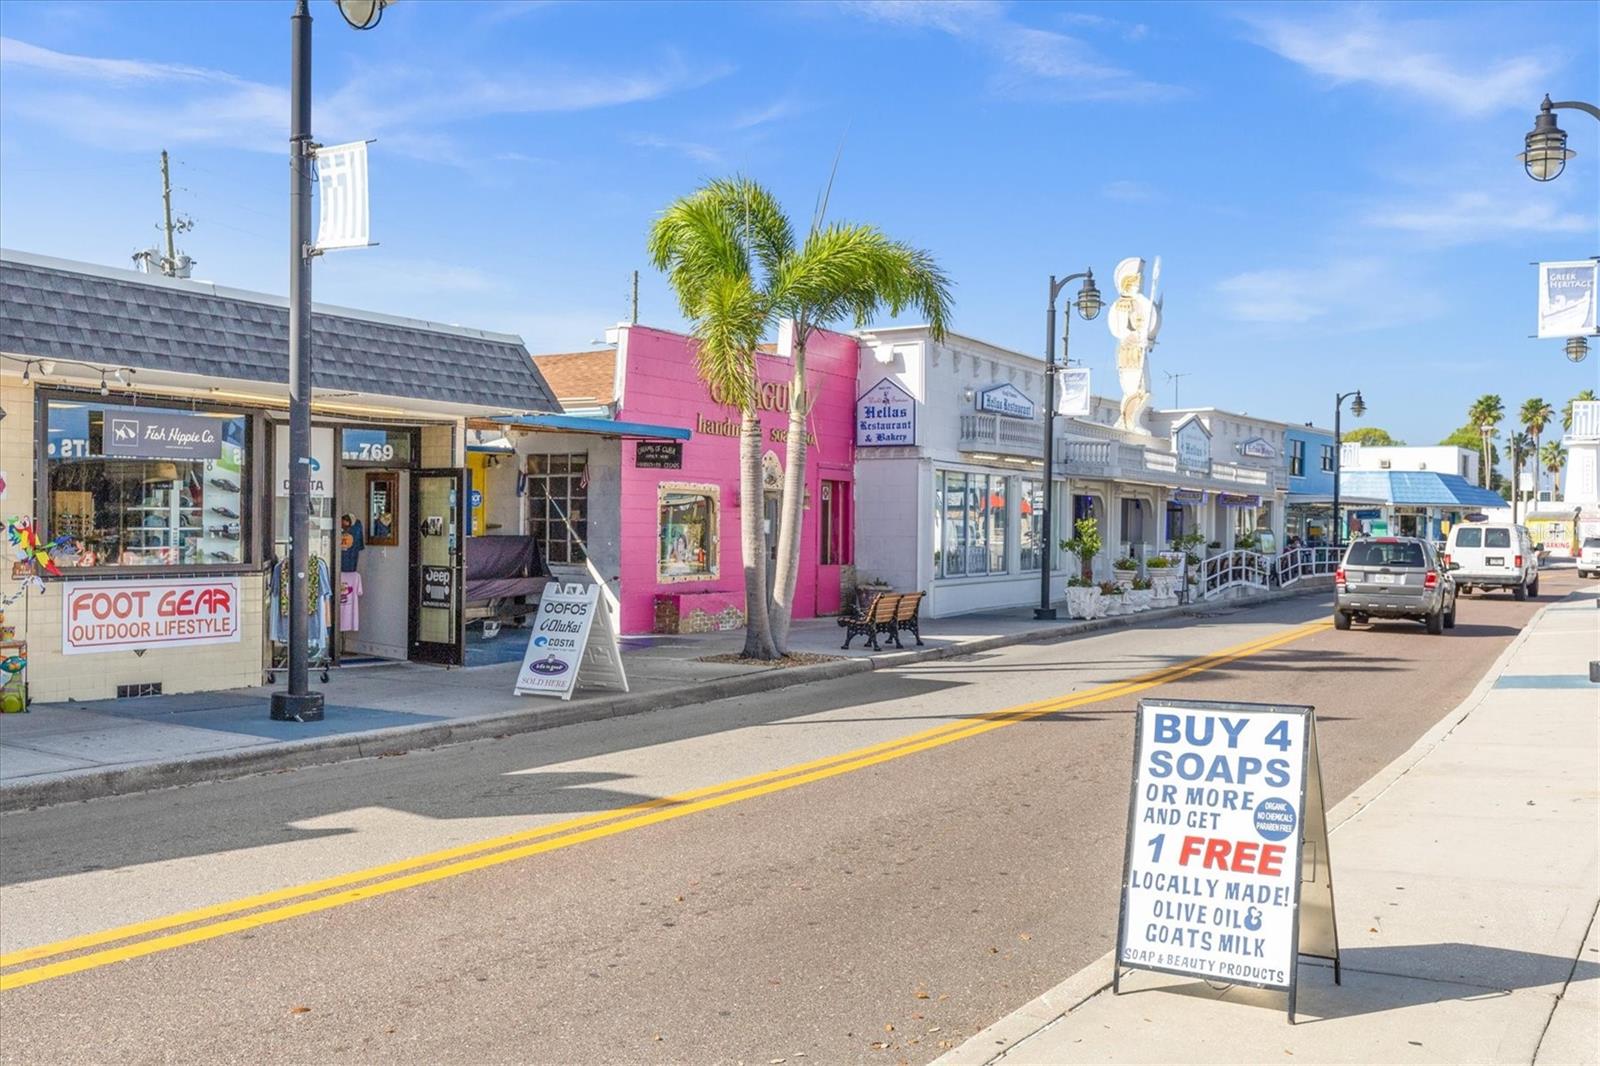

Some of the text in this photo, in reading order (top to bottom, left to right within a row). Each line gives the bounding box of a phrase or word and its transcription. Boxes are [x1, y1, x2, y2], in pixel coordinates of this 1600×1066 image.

[1550, 273, 1577, 281] GREEK
[1550, 280, 1591, 289] HERITAGE
[864, 405, 907, 418] Hellas
[860, 421, 911, 430] Restaurant
[144, 425, 215, 443] Fish Hippie Co.
[865, 433, 907, 442] & Bakery
[359, 443, 394, 460] 769
[283, 480, 324, 491] CTA
[426, 569, 450, 585] Jeep
[72, 588, 230, 621] FOOT GEAR
[544, 602, 588, 615] OOFOS
[72, 617, 230, 641] OUTDOOR LIFESTYLE
[548, 638, 575, 647] COSTA
[521, 677, 567, 687] SOLD HERE
[1153, 713, 1292, 752] BUY 4
[1148, 750, 1291, 788] SOAPS
[1146, 783, 1255, 811] OR MORE
[1265, 801, 1287, 811] ORGANIC
[1143, 807, 1221, 830] AND GET
[1257, 812, 1293, 822] NO CHEMICALS
[1256, 822, 1293, 833] PARABEN FREE
[1147, 833, 1286, 877] 1 FREE
[1132, 870, 1290, 907] LOCALLY MADE!
[1153, 900, 1207, 924] OLIVE
[1145, 923, 1266, 958] GOATS MILK
[1124, 948, 1285, 984] SOAP & BEAUTY PRODUCTS
